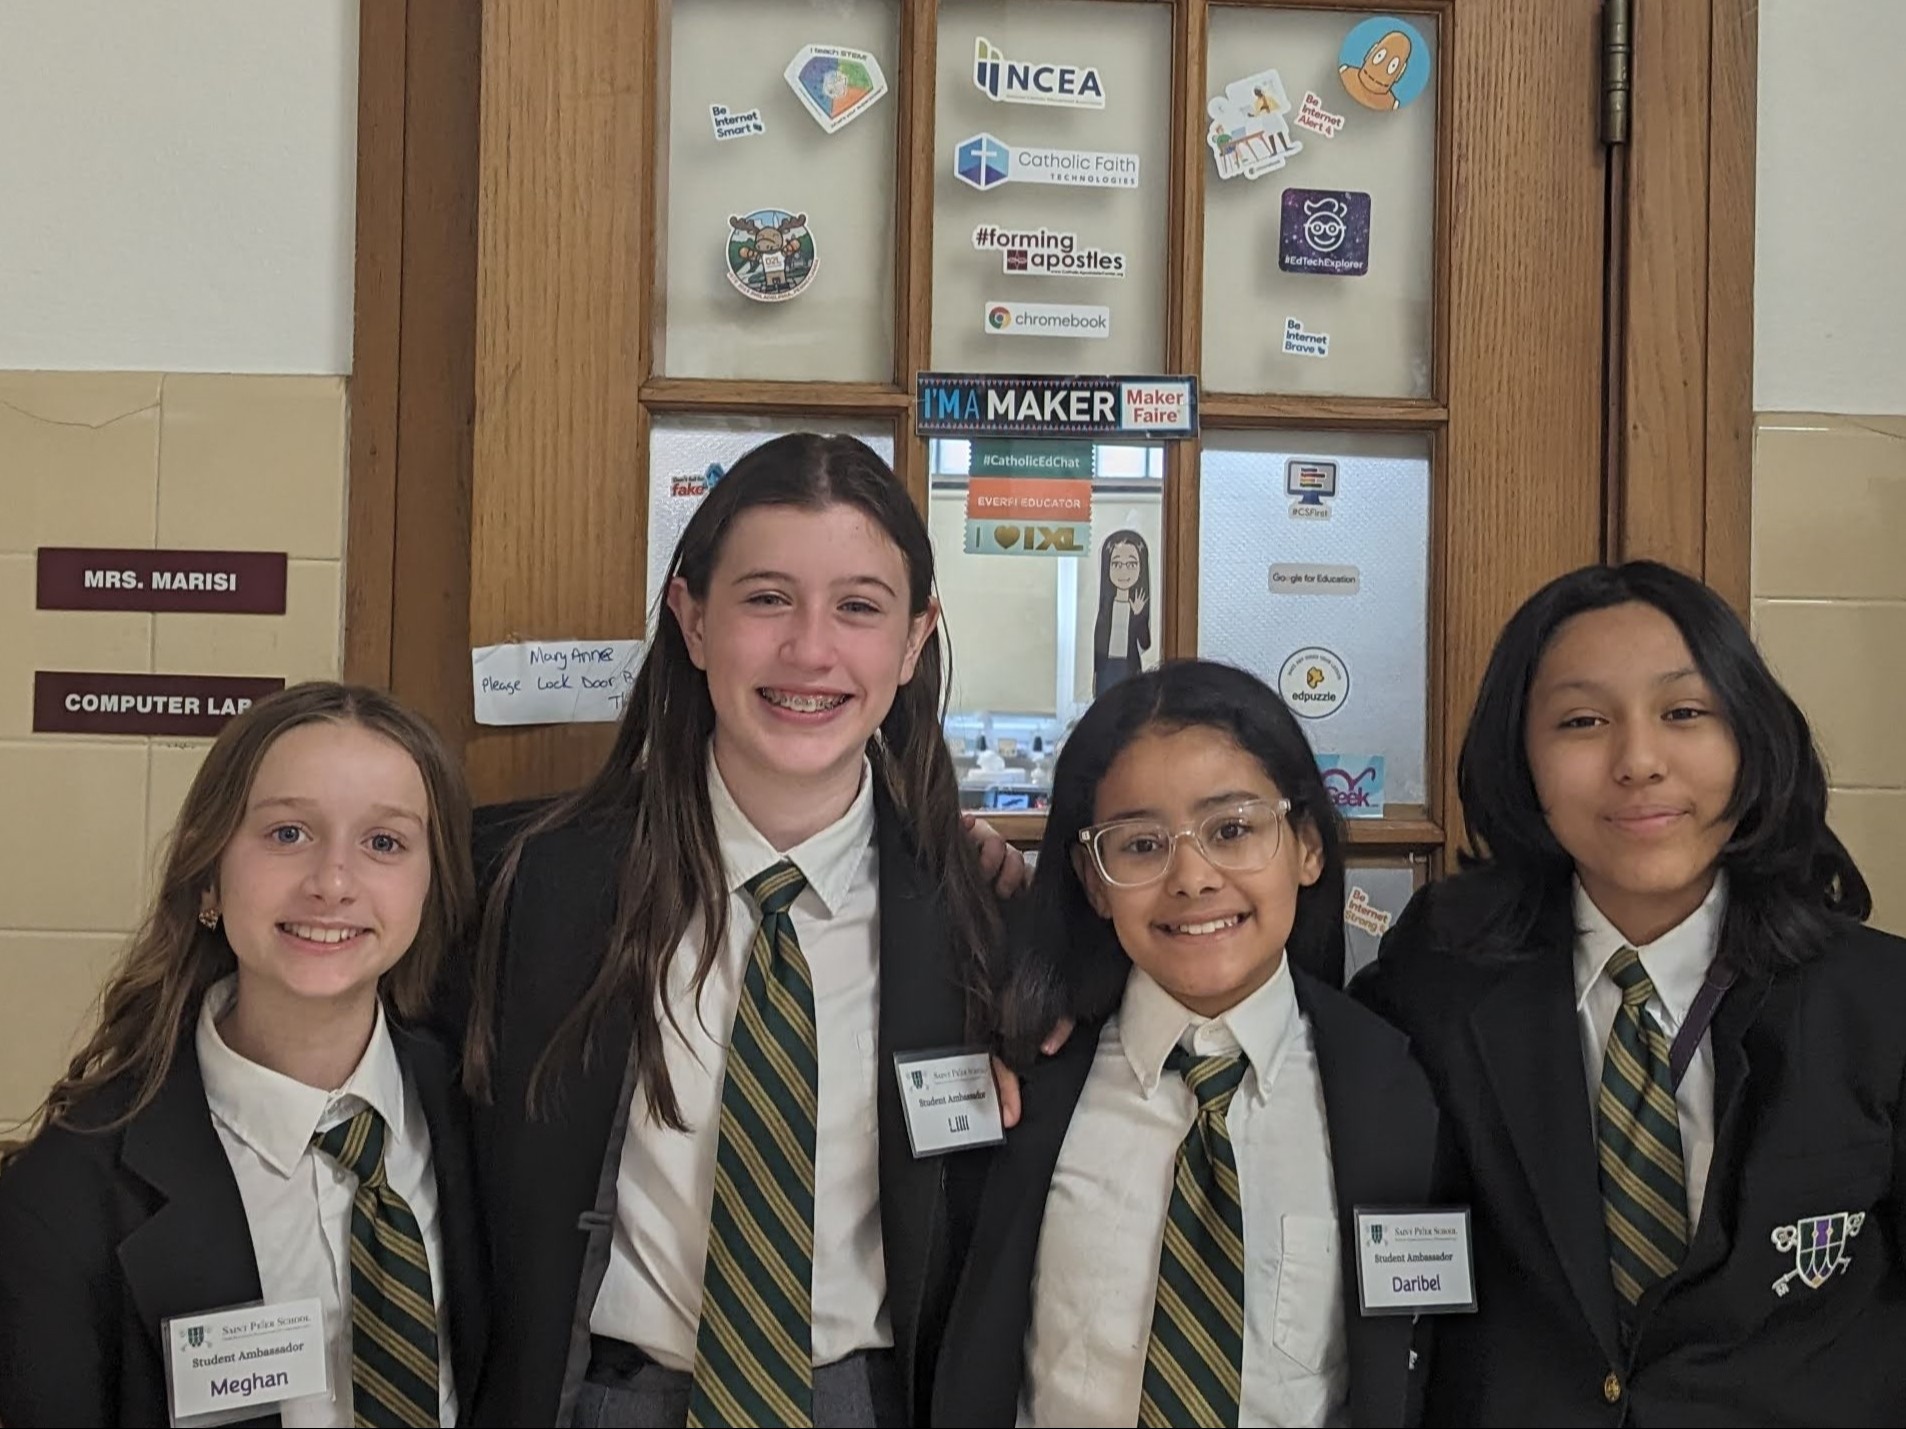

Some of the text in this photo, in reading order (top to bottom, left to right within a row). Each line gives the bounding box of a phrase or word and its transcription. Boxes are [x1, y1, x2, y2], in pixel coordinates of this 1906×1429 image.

[1007, 64, 1102, 97] NCEA
[1305, 93, 1319, 106] Be
[712, 106, 727, 116] Be
[715, 111, 758, 127] Internet
[1301, 104, 1342, 127] Internet
[1298, 114, 1324, 131] Alert
[717, 124, 751, 138] Smart
[1018, 151, 1136, 172] Catholic Faith
[1050, 172, 1136, 185] TECHNOLOGIES
[976, 227, 1074, 253] #forming
[1031, 251, 1123, 271] apostles
[1284, 254, 1364, 270] #EdTechExplorer
[1015, 312, 1107, 329] chromebook
[1287, 319, 1301, 330] Be
[1285, 330, 1328, 345] Internet
[1284, 341, 1316, 353] Brave
[924, 388, 1116, 422] I'M A MAKER
[1127, 389, 1184, 405] Maker
[1134, 407, 1178, 423] Faire
[983, 454, 1080, 468] #CatholicEdChat
[672, 482, 705, 497] fake
[978, 496, 1081, 509] EVERFI EDUCATOR
[1292, 507, 1328, 518] #CSFirst
[976, 526, 1084, 551] I IXL
[84, 570, 237, 592] MRS. MARISI
[1272, 572, 1356, 584] Gogle for Education
[482, 676, 522, 695] Please
[537, 674, 573, 690] Lock
[581, 676, 616, 690] Door
[65, 693, 200, 715] COMPUTER
[1292, 690, 1337, 703] edpuzzle
[1352, 889, 1366, 902] Be
[1348, 899, 1388, 924] Internet
[1345, 910, 1378, 933] Strong
[919, 1090, 986, 1107] Student Ambassador
[1374, 1251, 1454, 1264] Student Ambassador
[1392, 1274, 1442, 1293] Daribel
[192, 1341, 305, 1369] Student Ambassador
[210, 1370, 289, 1398] Meghan
